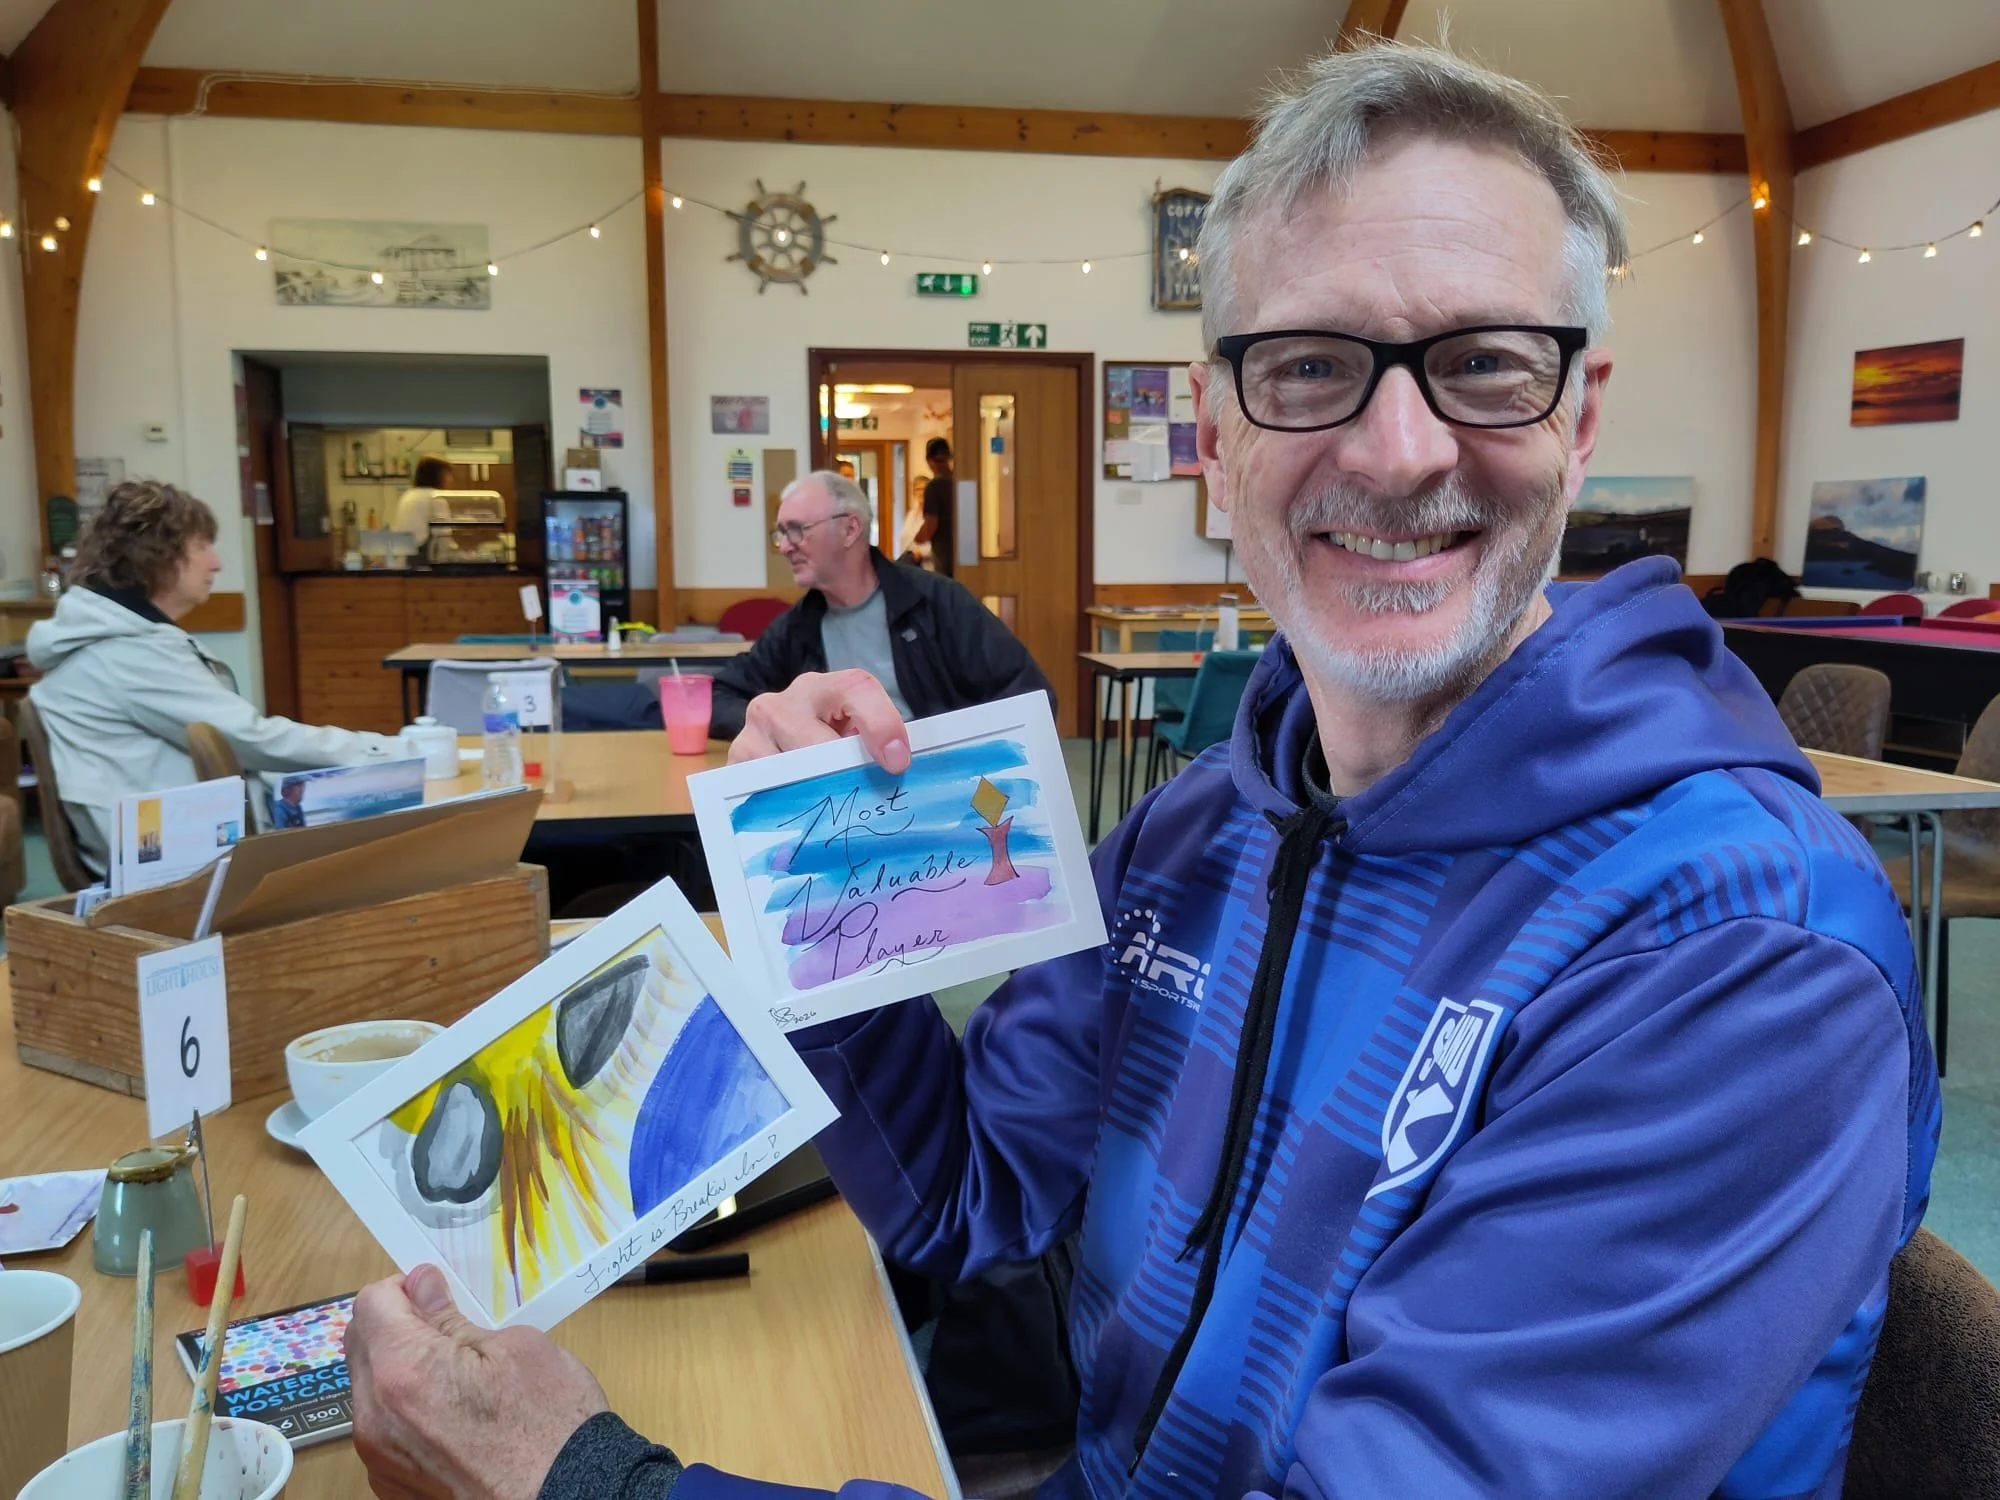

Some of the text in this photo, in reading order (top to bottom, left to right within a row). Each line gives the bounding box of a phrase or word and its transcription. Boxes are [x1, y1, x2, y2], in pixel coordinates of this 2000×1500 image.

[1167, 205, 1202, 219] COFF
[1174, 283, 1200, 297] TIM
[970, 324, 989, 333] FIRE
[523, 695, 537, 713] 3
[778, 786, 910, 866] Most
[785, 851, 978, 941] Valuable
[803, 902, 949, 980] Player
[181, 1016, 200, 1078] 6
[576, 1235, 642, 1294] Light
[650, 1225, 666, 1242] is
[224, 1364, 350, 1404] WATERCO
[228, 1376, 351, 1417] POSTCAR
[306, 1407, 340, 1422] 300
